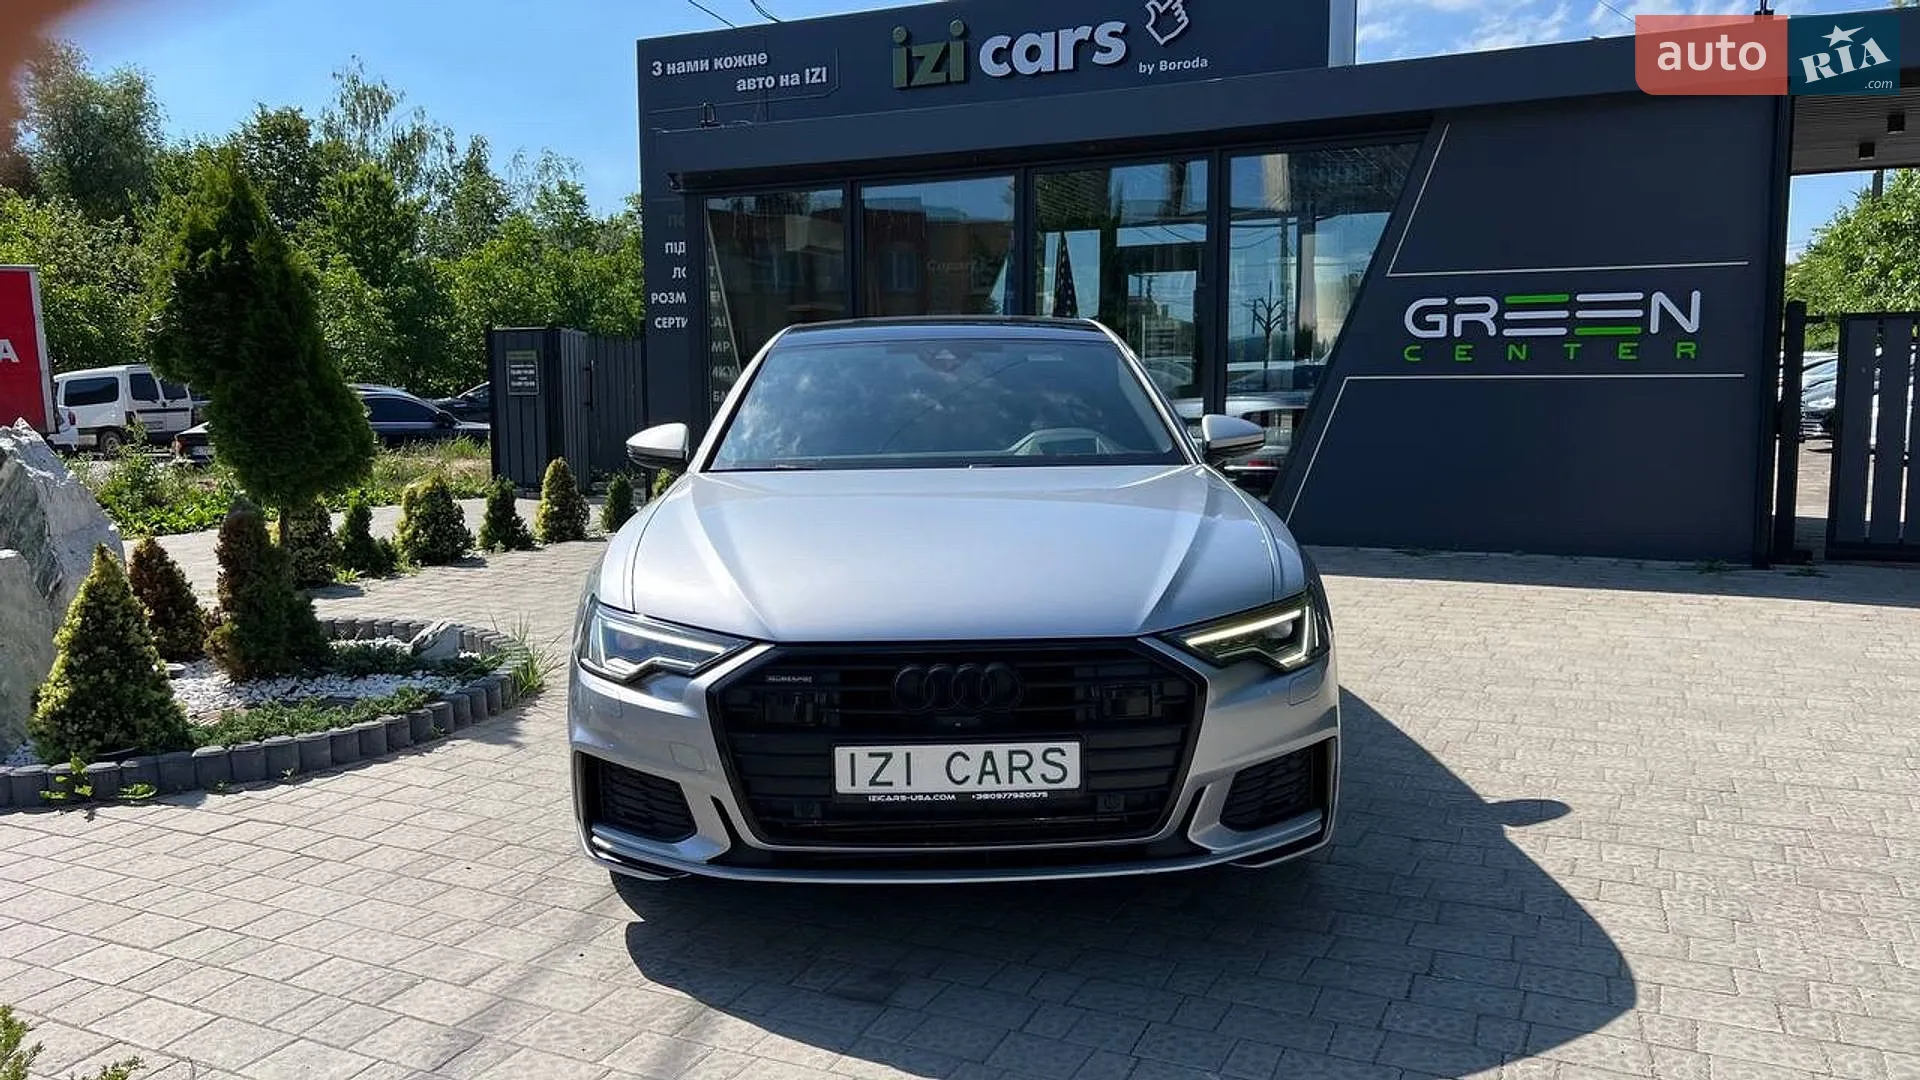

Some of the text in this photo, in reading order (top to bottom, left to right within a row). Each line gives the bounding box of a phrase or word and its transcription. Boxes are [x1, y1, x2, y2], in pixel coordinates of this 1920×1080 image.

[666, 57, 710, 75] нами
[713, 52, 768, 70] кожне
[892, 19, 1127, 88] izi cars
[1138, 56, 1209, 75] by Boroda
[736, 76, 775, 91] авто
[779, 73, 800, 87] на
[1404, 290, 1701, 339] GREEN
[1404, 342, 1697, 361] CENTER
[850, 747, 1068, 787] IZI CARS
